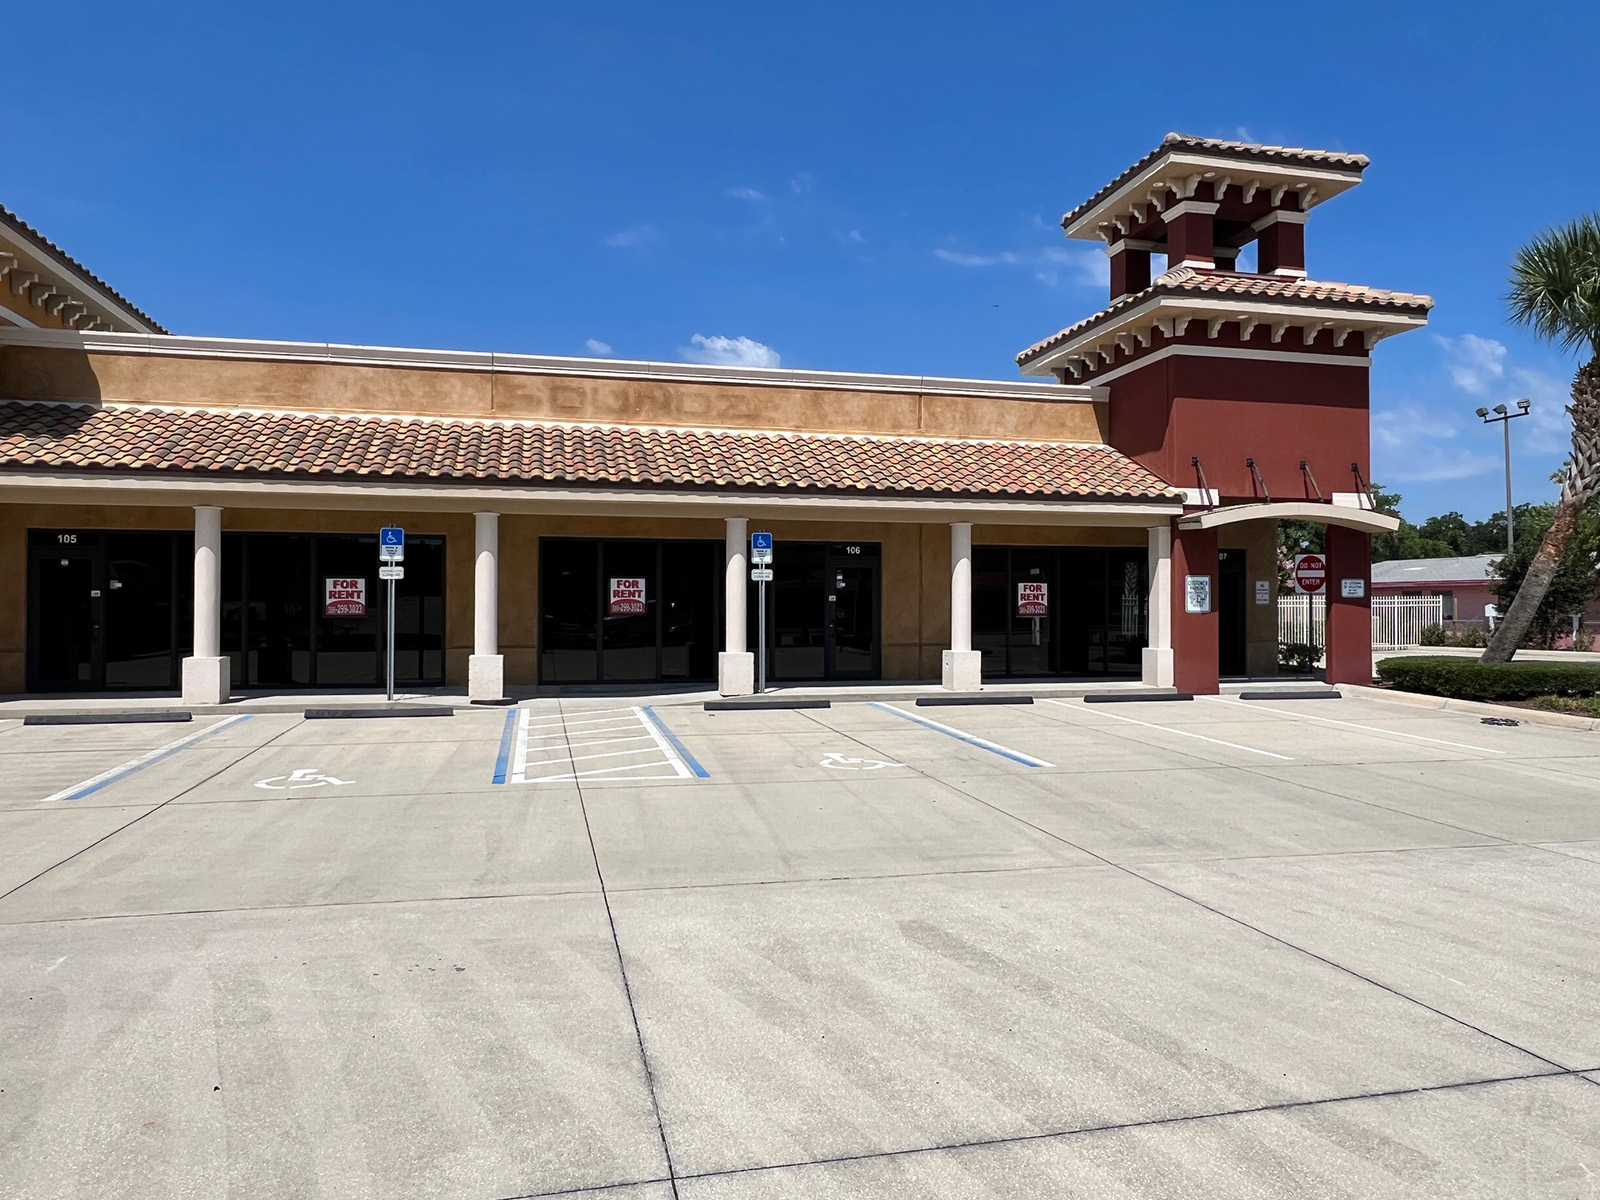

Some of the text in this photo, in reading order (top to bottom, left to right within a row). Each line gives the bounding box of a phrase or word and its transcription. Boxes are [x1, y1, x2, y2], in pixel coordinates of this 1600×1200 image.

[57, 534, 77, 544] 105
[846, 546, 861, 555] 106
[1218, 553, 1228, 561] 07
[332, 579, 359, 590] FOR
[616, 579, 640, 589] FOR
[1301, 578, 1321, 586] ENTER
[1023, 584, 1043, 593] FOR
[328, 590, 364, 600] RENT
[612, 589, 644, 599] RENT
[1020, 593, 1046, 602] RENT
